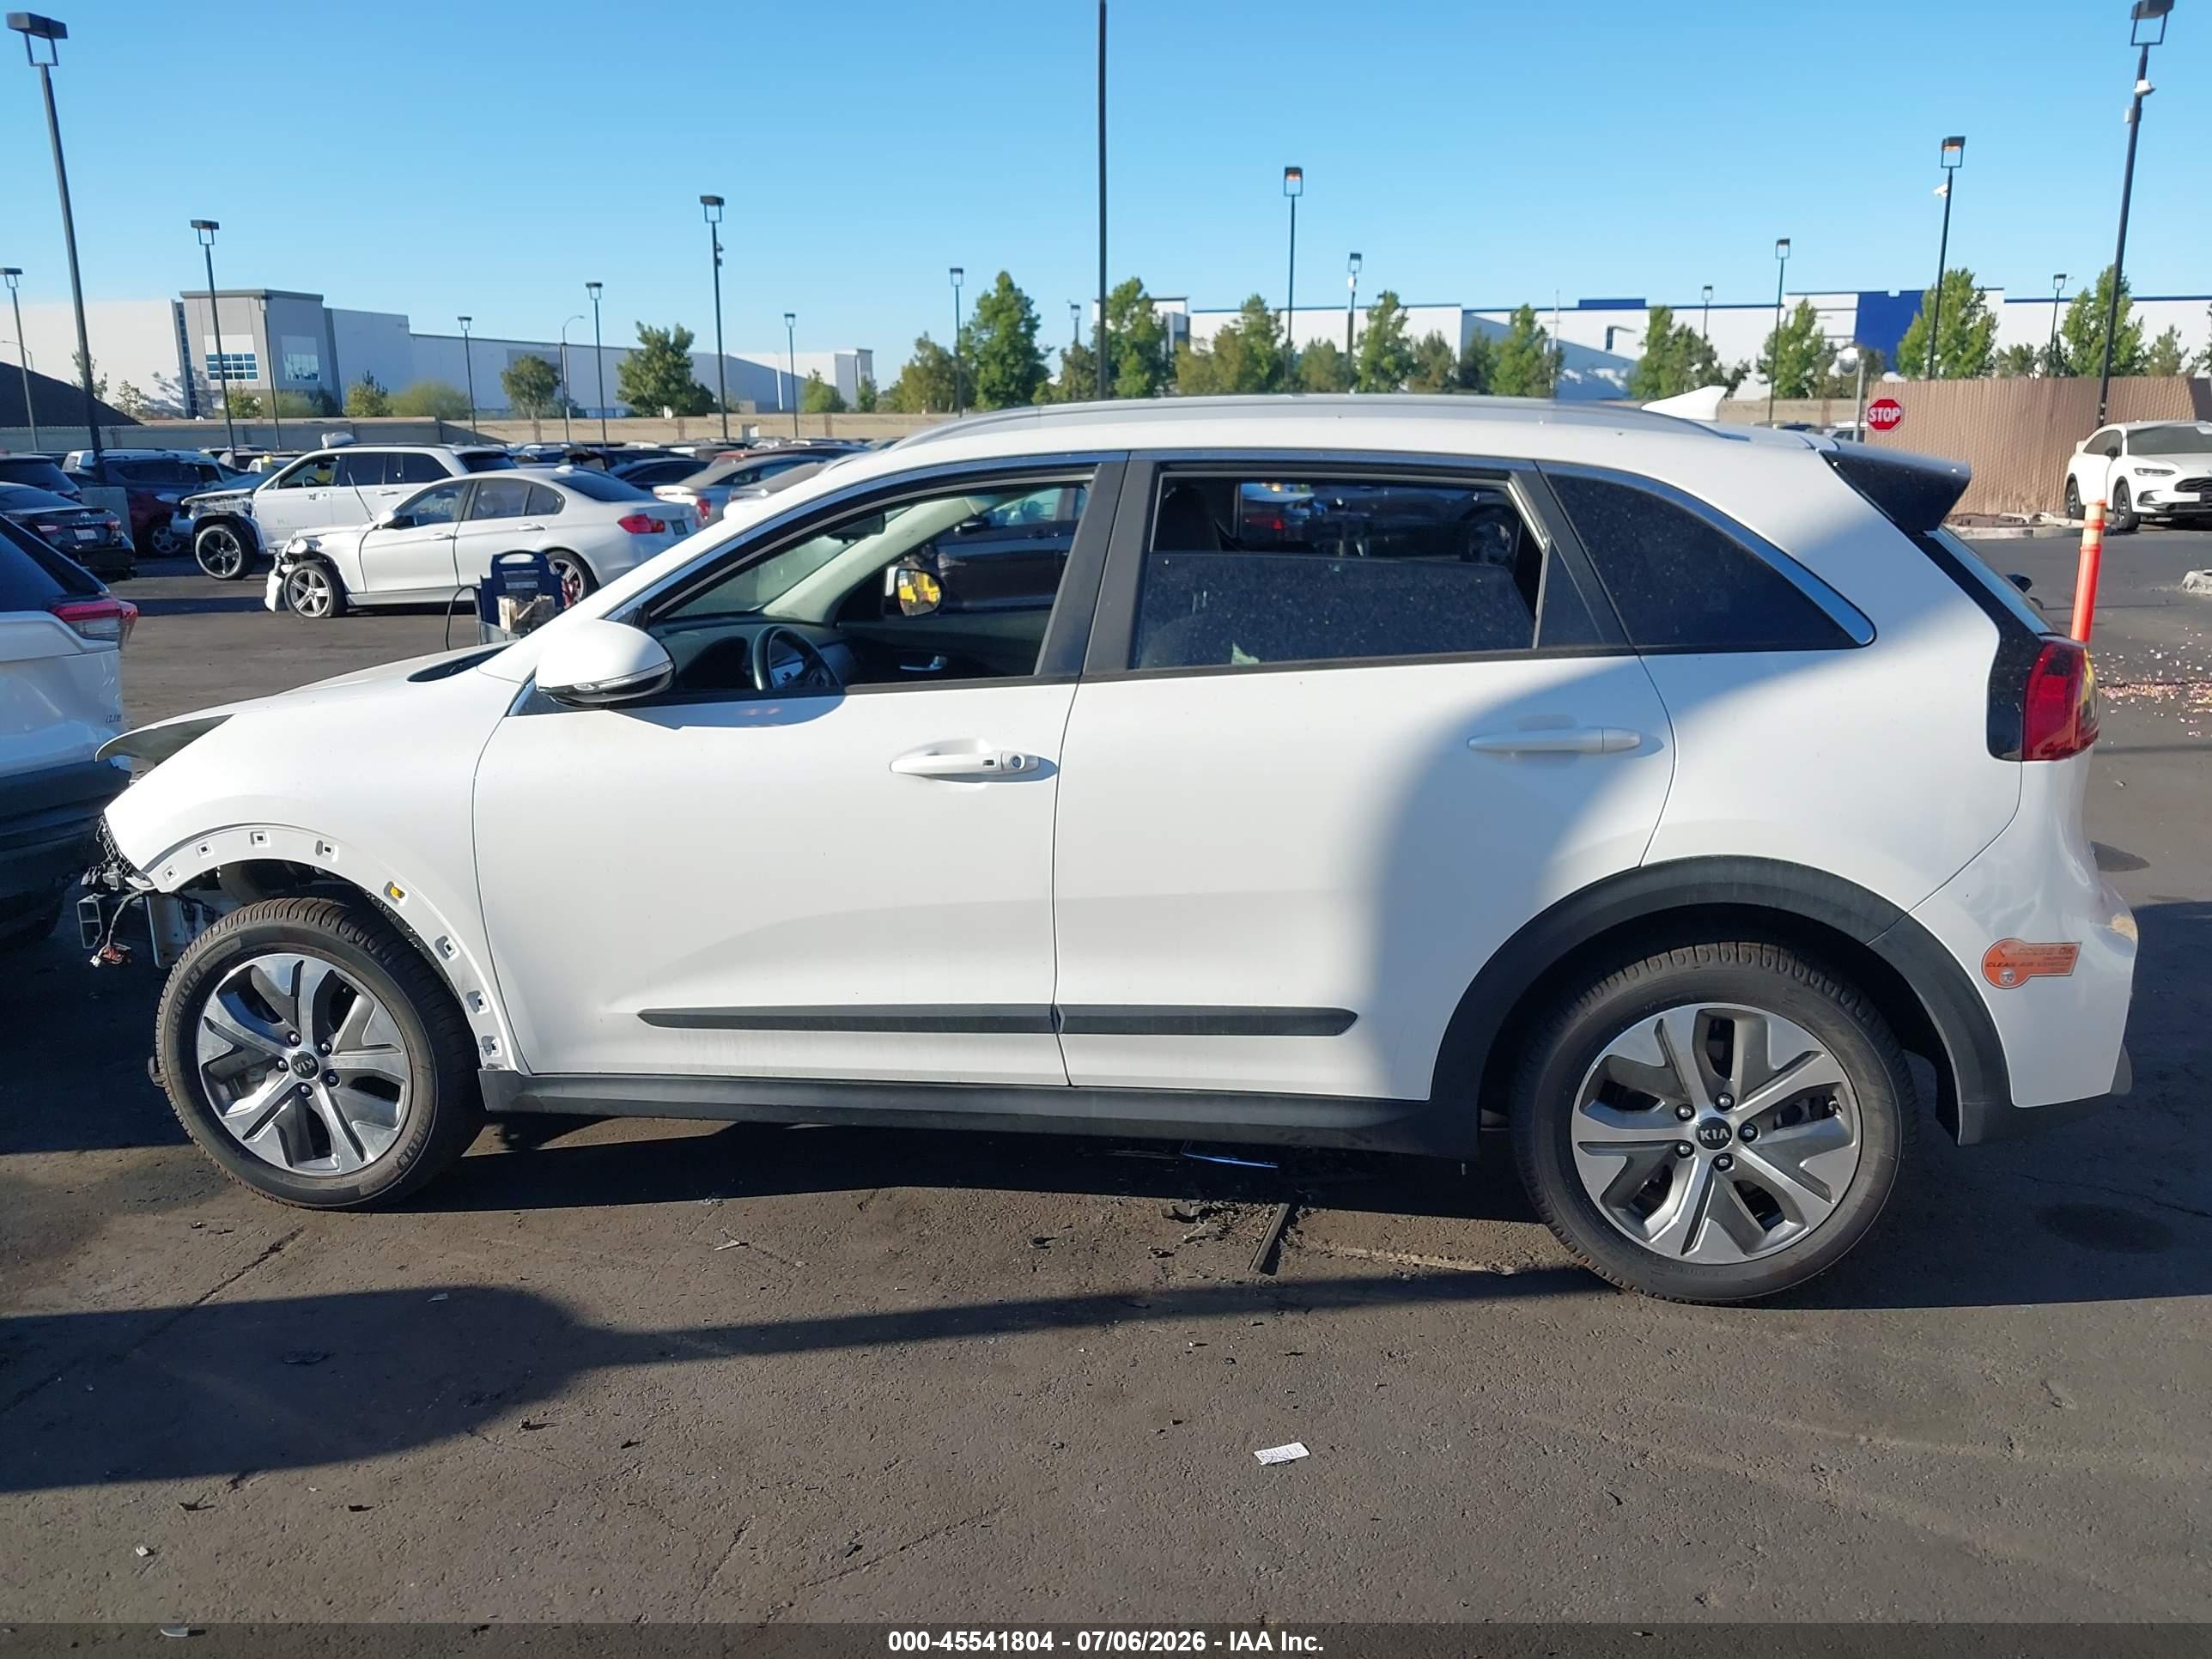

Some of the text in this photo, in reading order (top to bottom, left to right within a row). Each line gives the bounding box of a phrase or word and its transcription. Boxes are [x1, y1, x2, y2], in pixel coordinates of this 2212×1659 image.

[1869, 407, 1901, 422] STOP
[2058, 946, 2075, 956] OK
[293, 1058, 315, 1073] KIA
[1699, 1127, 1730, 1141] KIA
